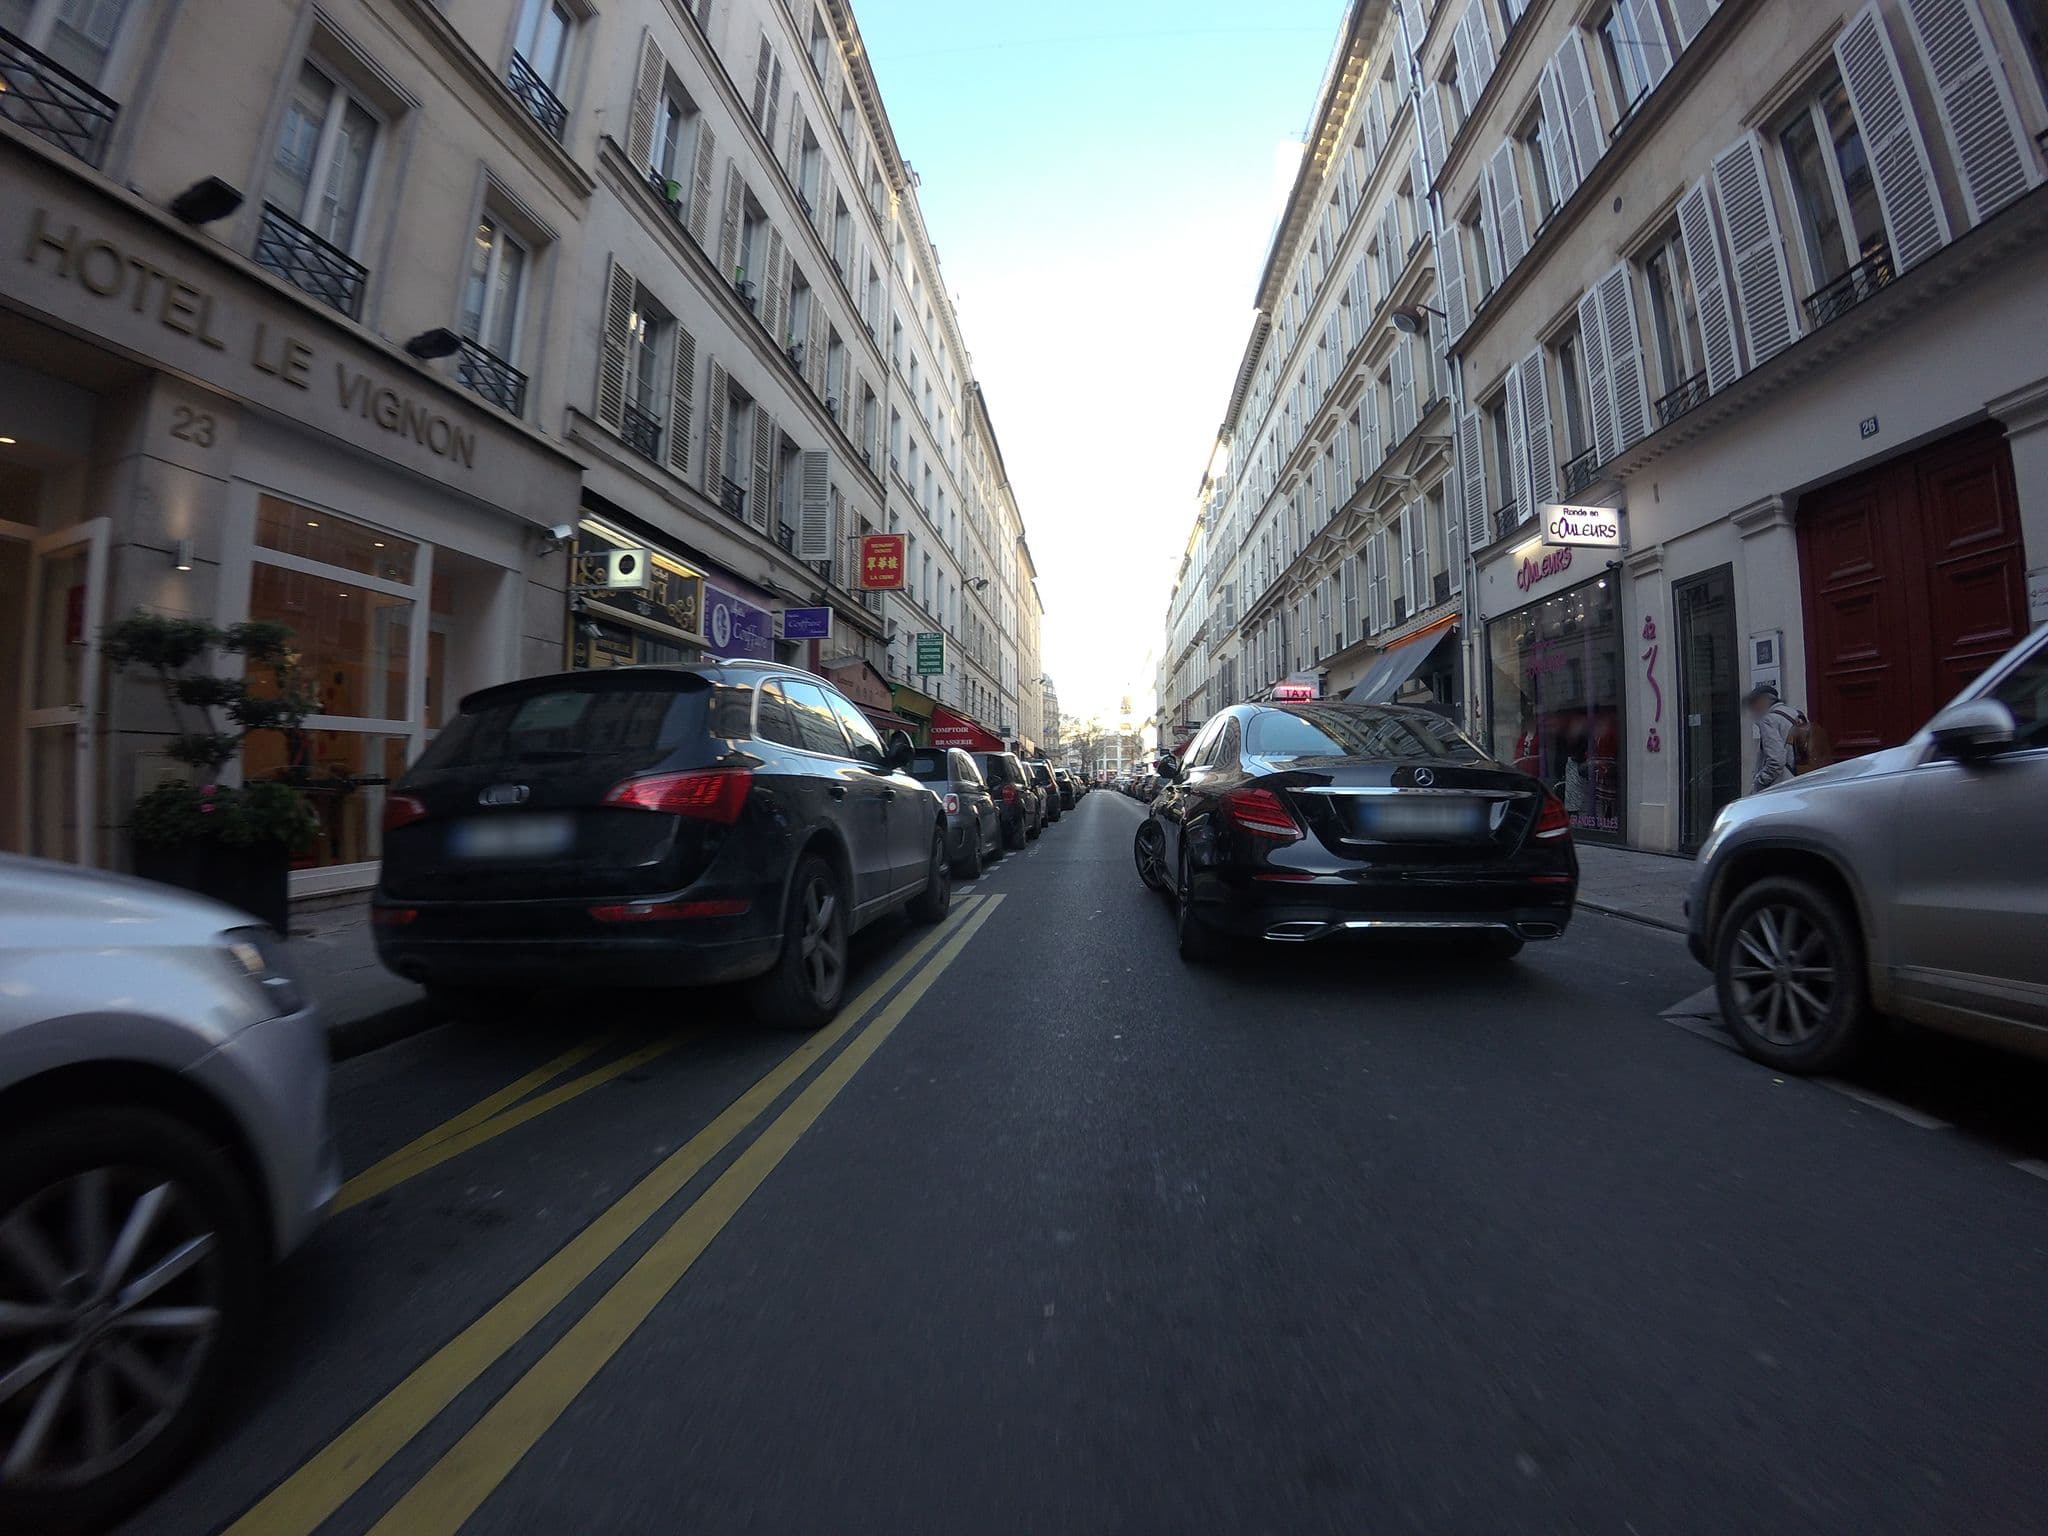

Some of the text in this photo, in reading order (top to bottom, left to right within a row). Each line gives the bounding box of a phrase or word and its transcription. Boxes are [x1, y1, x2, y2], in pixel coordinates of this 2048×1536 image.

[25, 208, 476, 470] HOTEL LE VIGNON
[170, 405, 217, 449] 23
[1286, 689, 1312, 698] TAXI
